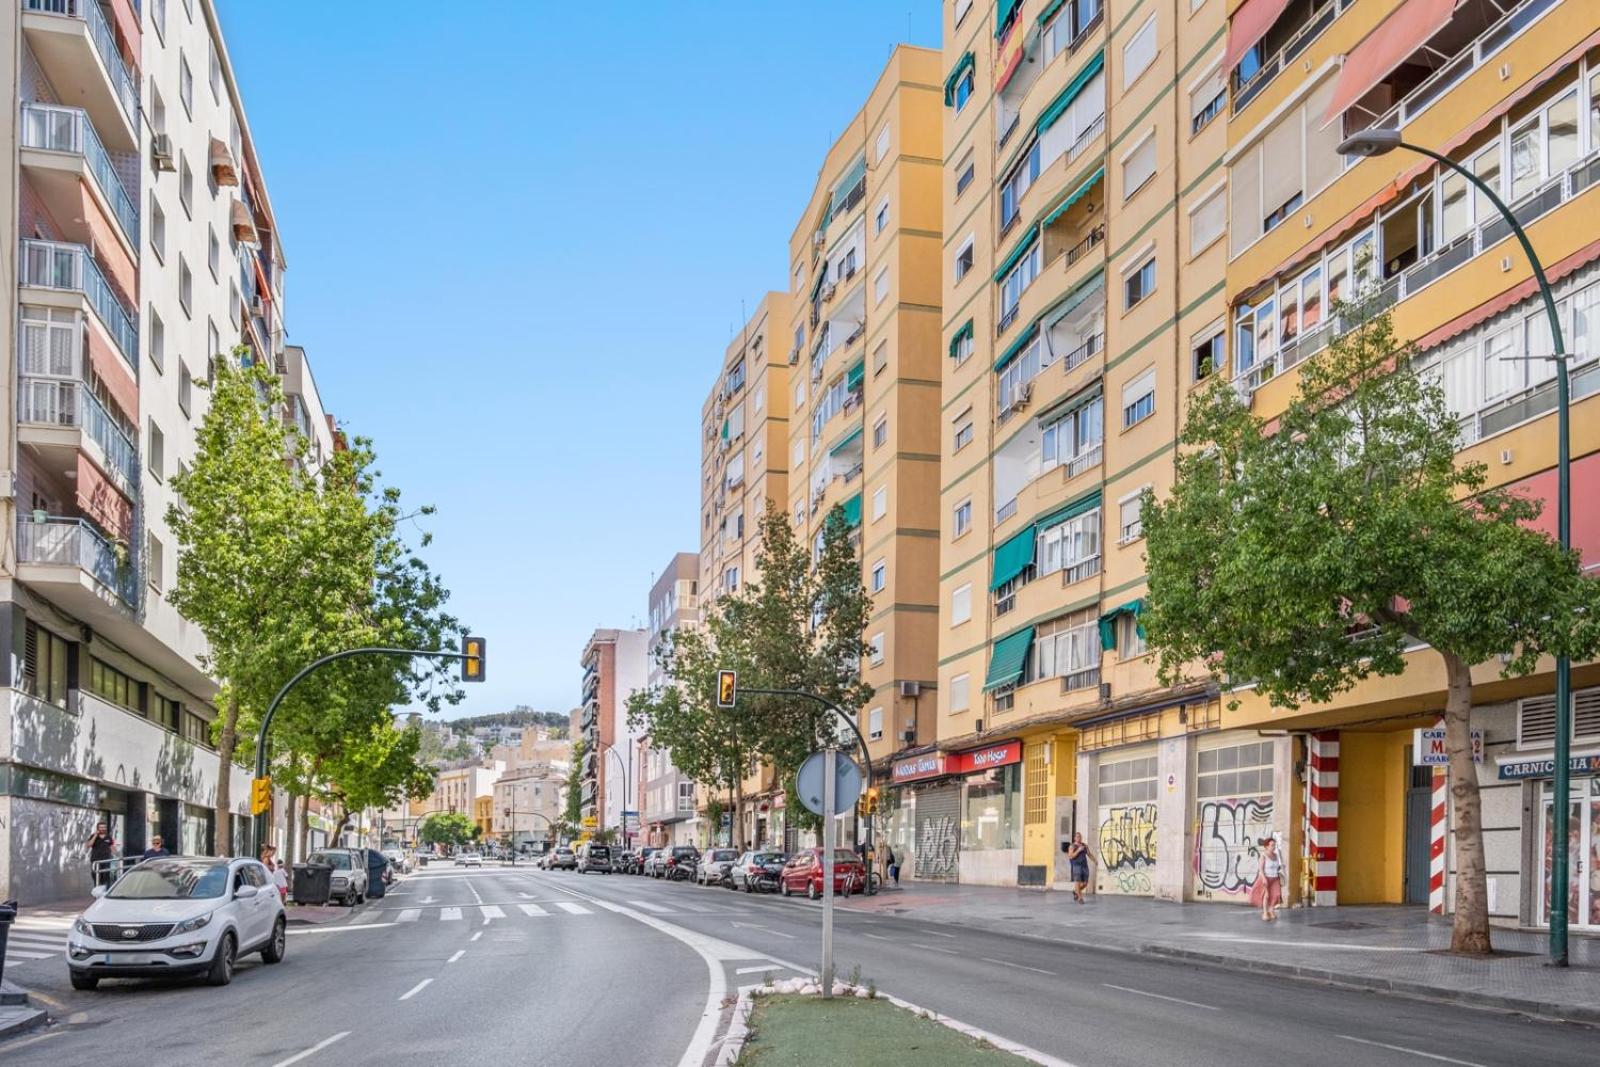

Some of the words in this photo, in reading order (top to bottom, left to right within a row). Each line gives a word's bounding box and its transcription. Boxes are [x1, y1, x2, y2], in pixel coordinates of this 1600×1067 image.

[1423, 731, 1480, 739] CARIA
[1423, 755, 1481, 763] CHARIA
[1504, 758, 1587, 775] CARNICIA
